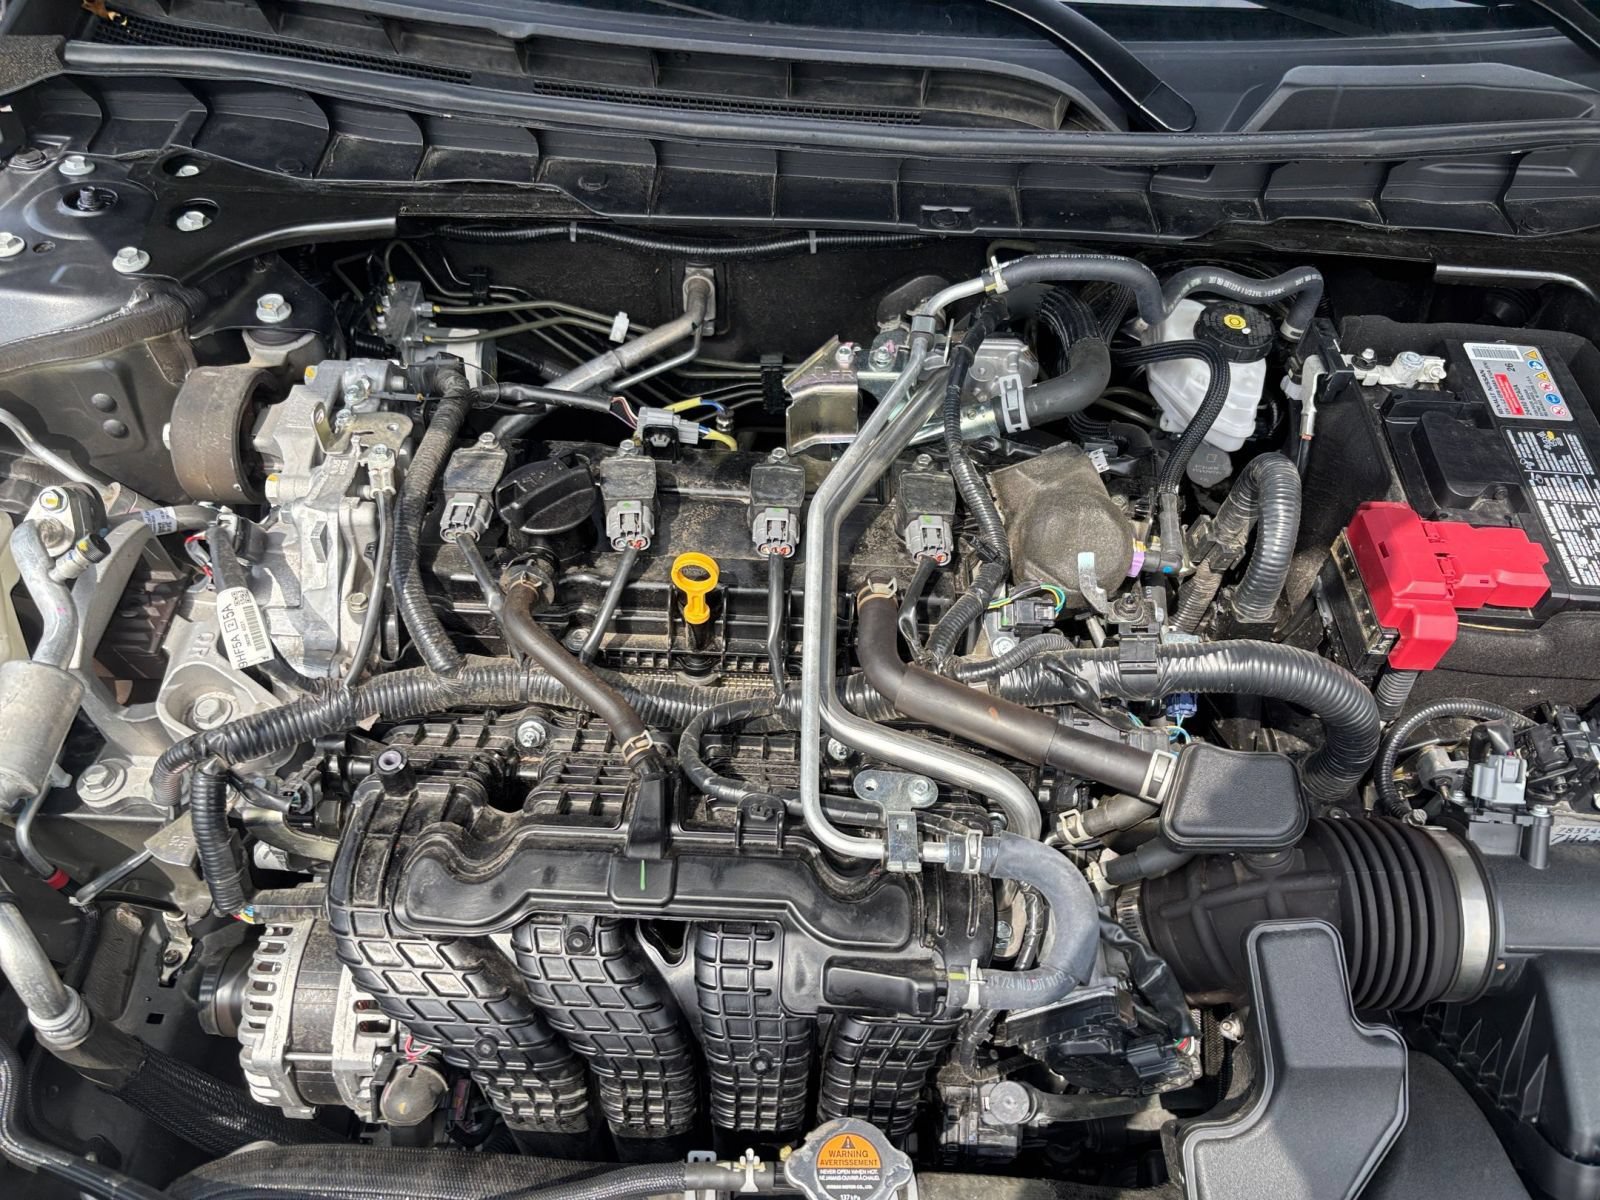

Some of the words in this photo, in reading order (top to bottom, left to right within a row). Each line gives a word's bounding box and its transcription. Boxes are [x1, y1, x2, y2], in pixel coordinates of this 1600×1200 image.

[1503, 362, 1516, 371] 26
[1478, 369, 1493, 390] NISSAN
[1488, 392, 1504, 414] RENAULT
[221, 603, 235, 620] 5A
[230, 634, 249, 668] 9HF5A
[828, 1150, 868, 1158] WARNING
